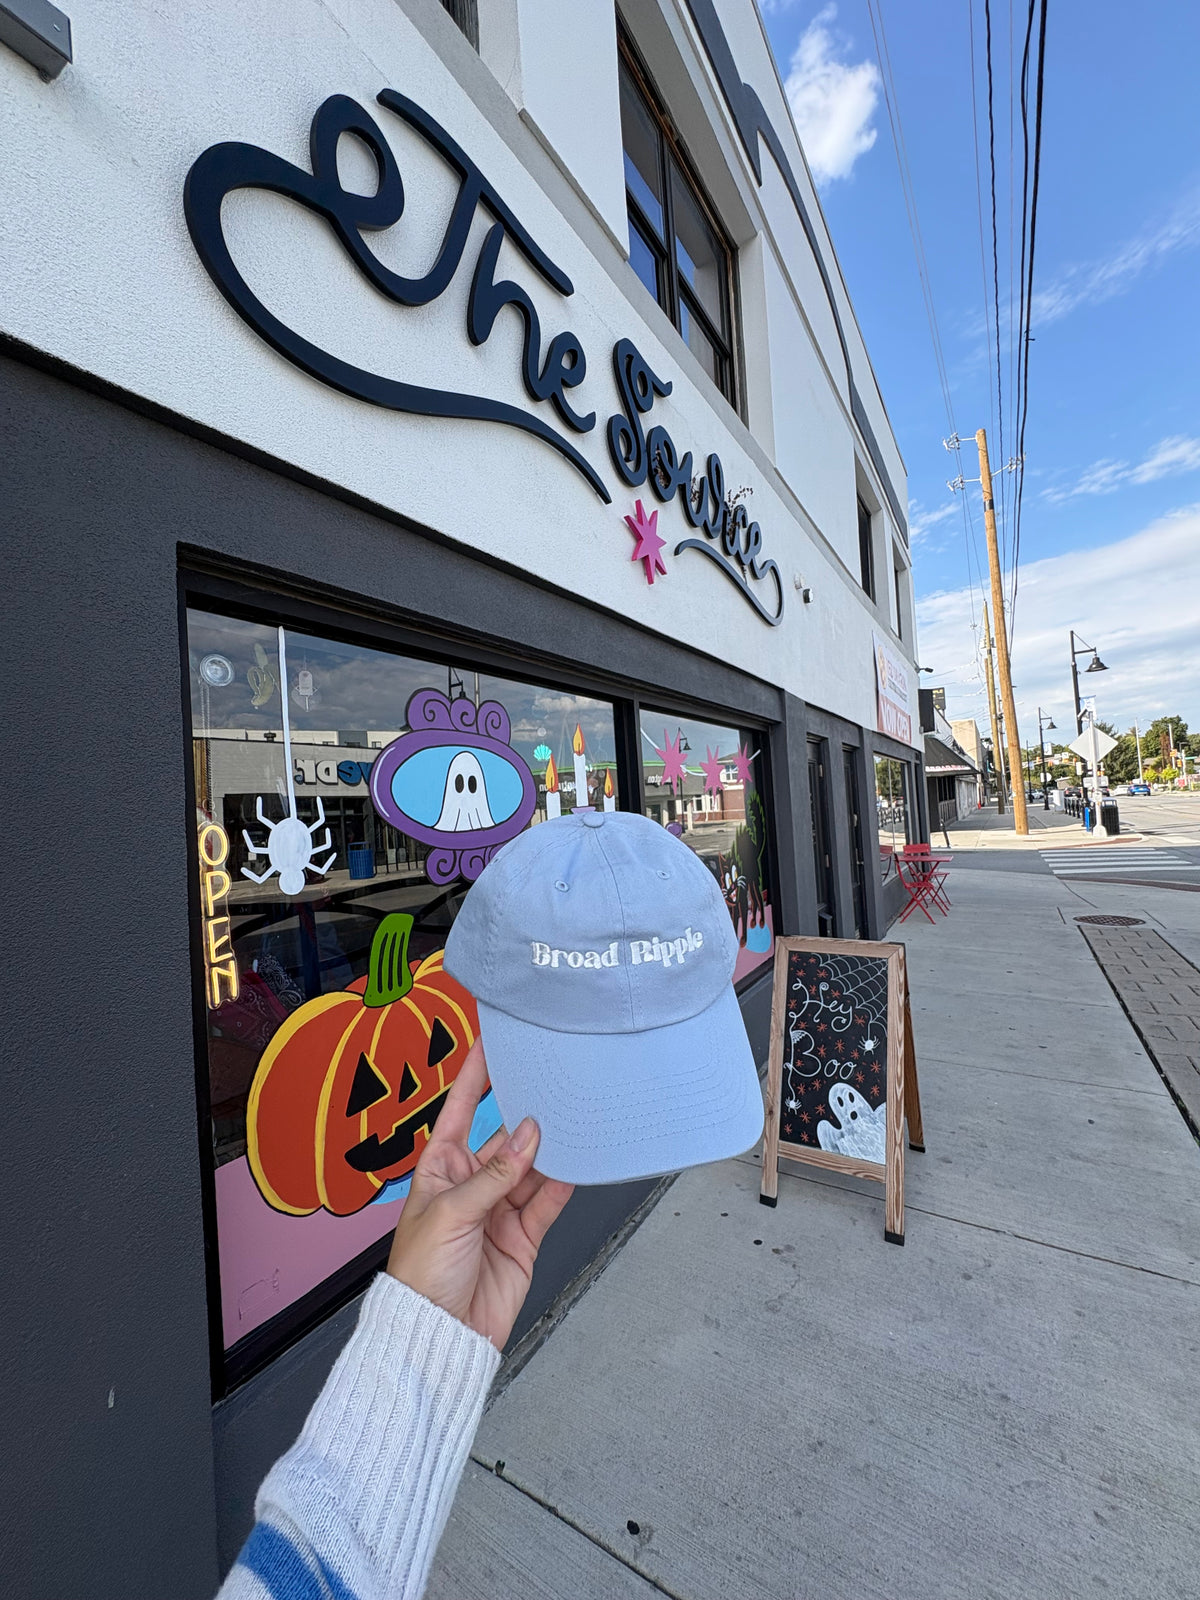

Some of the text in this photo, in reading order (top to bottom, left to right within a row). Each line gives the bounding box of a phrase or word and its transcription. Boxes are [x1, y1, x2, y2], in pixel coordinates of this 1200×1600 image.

[184, 88, 611, 504] The
[200, 824, 238, 1007] OPEN
[531, 927, 704, 969] Broad Ripple
[789, 978, 853, 1033] Hey
[783, 1029, 857, 1080] Boo
